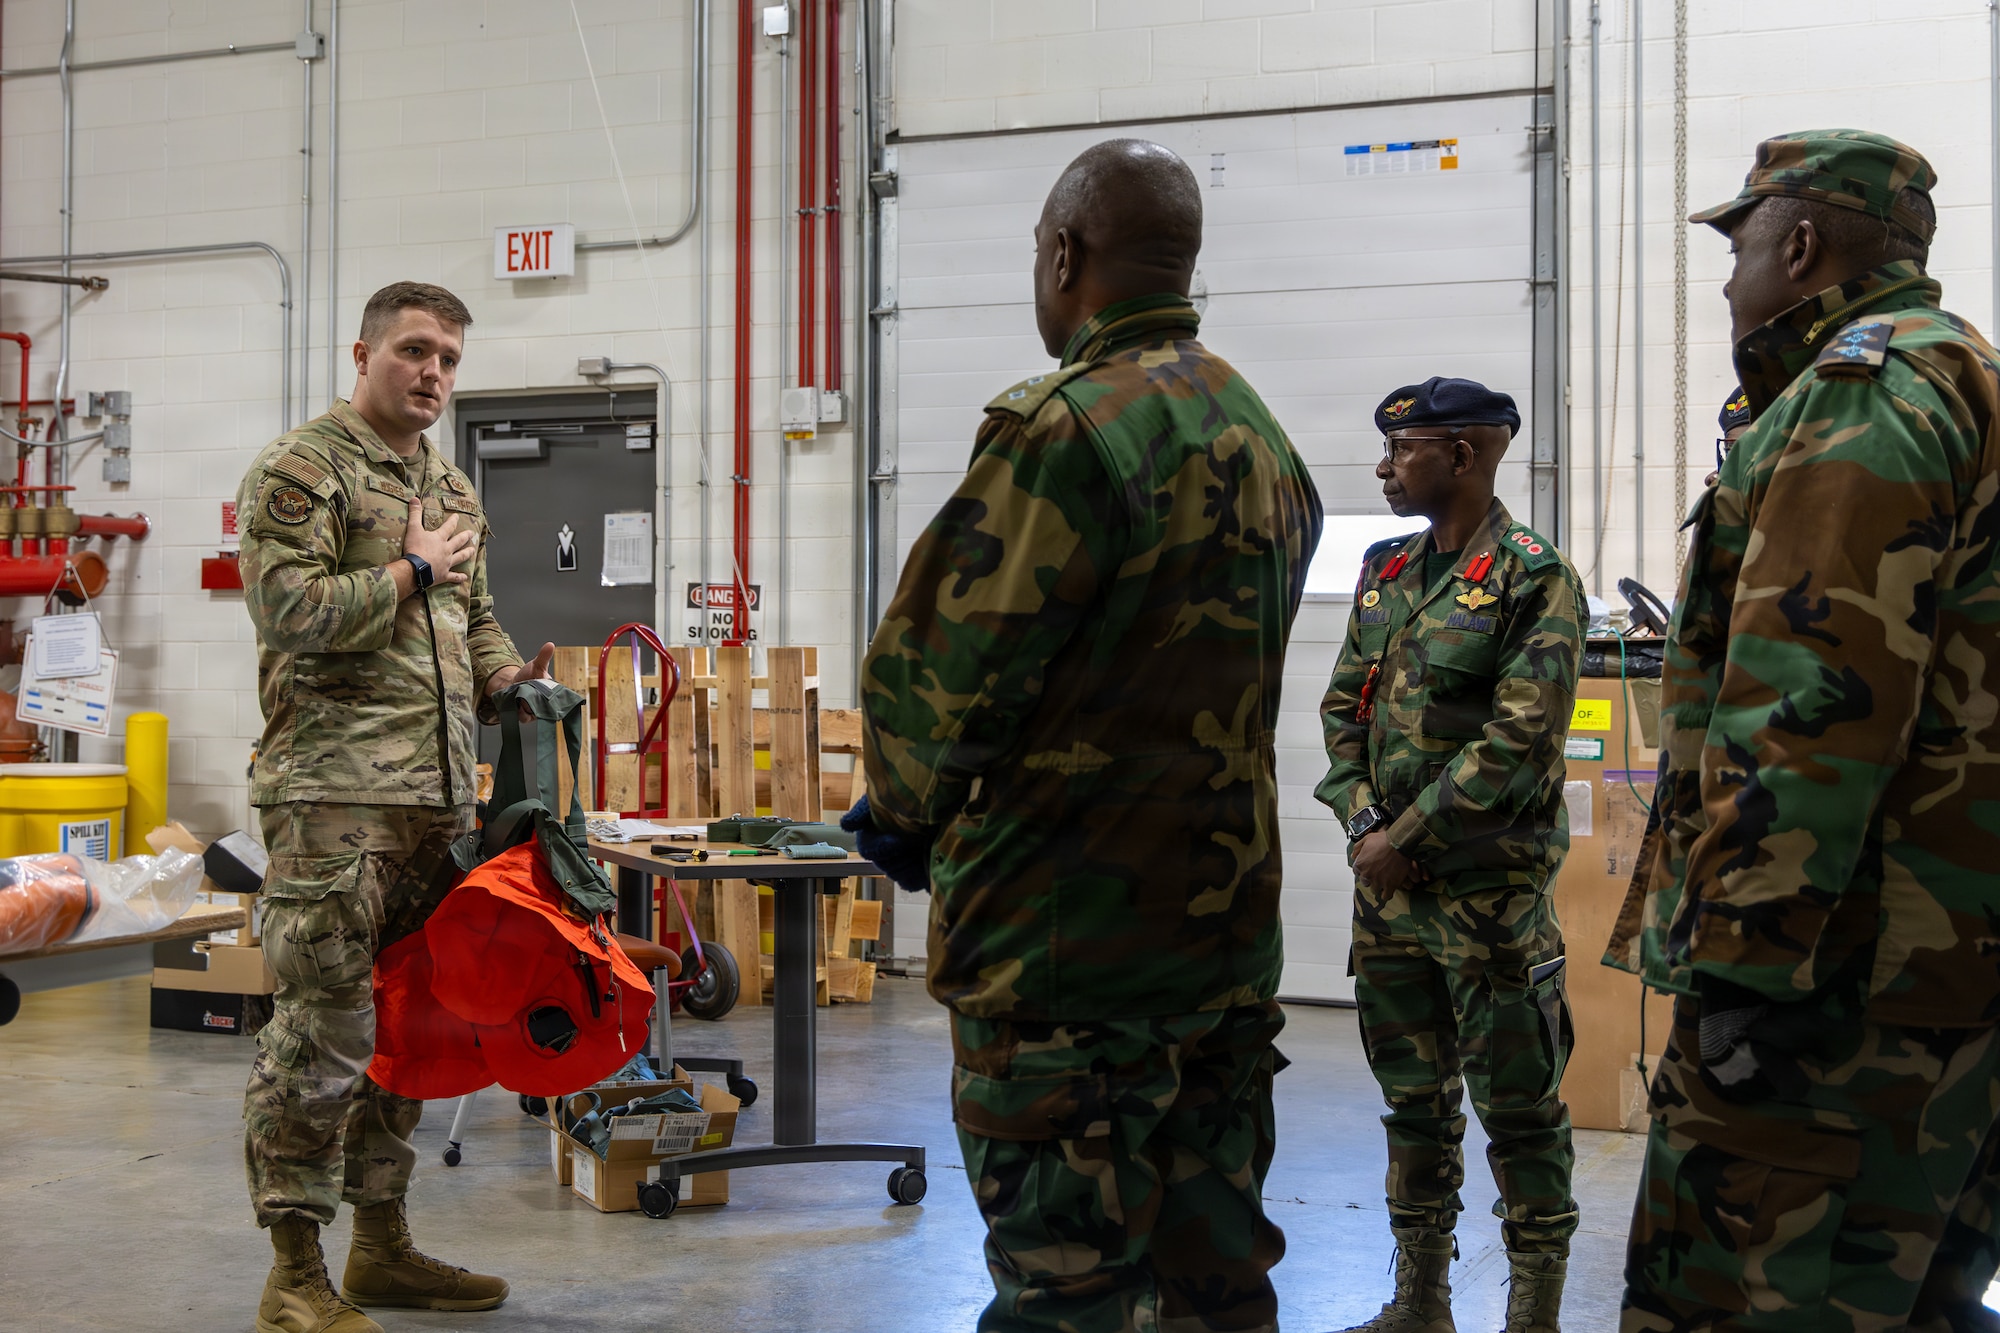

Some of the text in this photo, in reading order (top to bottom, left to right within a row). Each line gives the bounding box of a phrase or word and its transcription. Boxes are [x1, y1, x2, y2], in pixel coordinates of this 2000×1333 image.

[507, 230, 554, 272] EXIT
[713, 613, 734, 625] NO
[1447, 612, 1491, 632] MALAWI
[1577, 710, 1594, 719] OF
[70, 823, 105, 839] SPILL KIT
